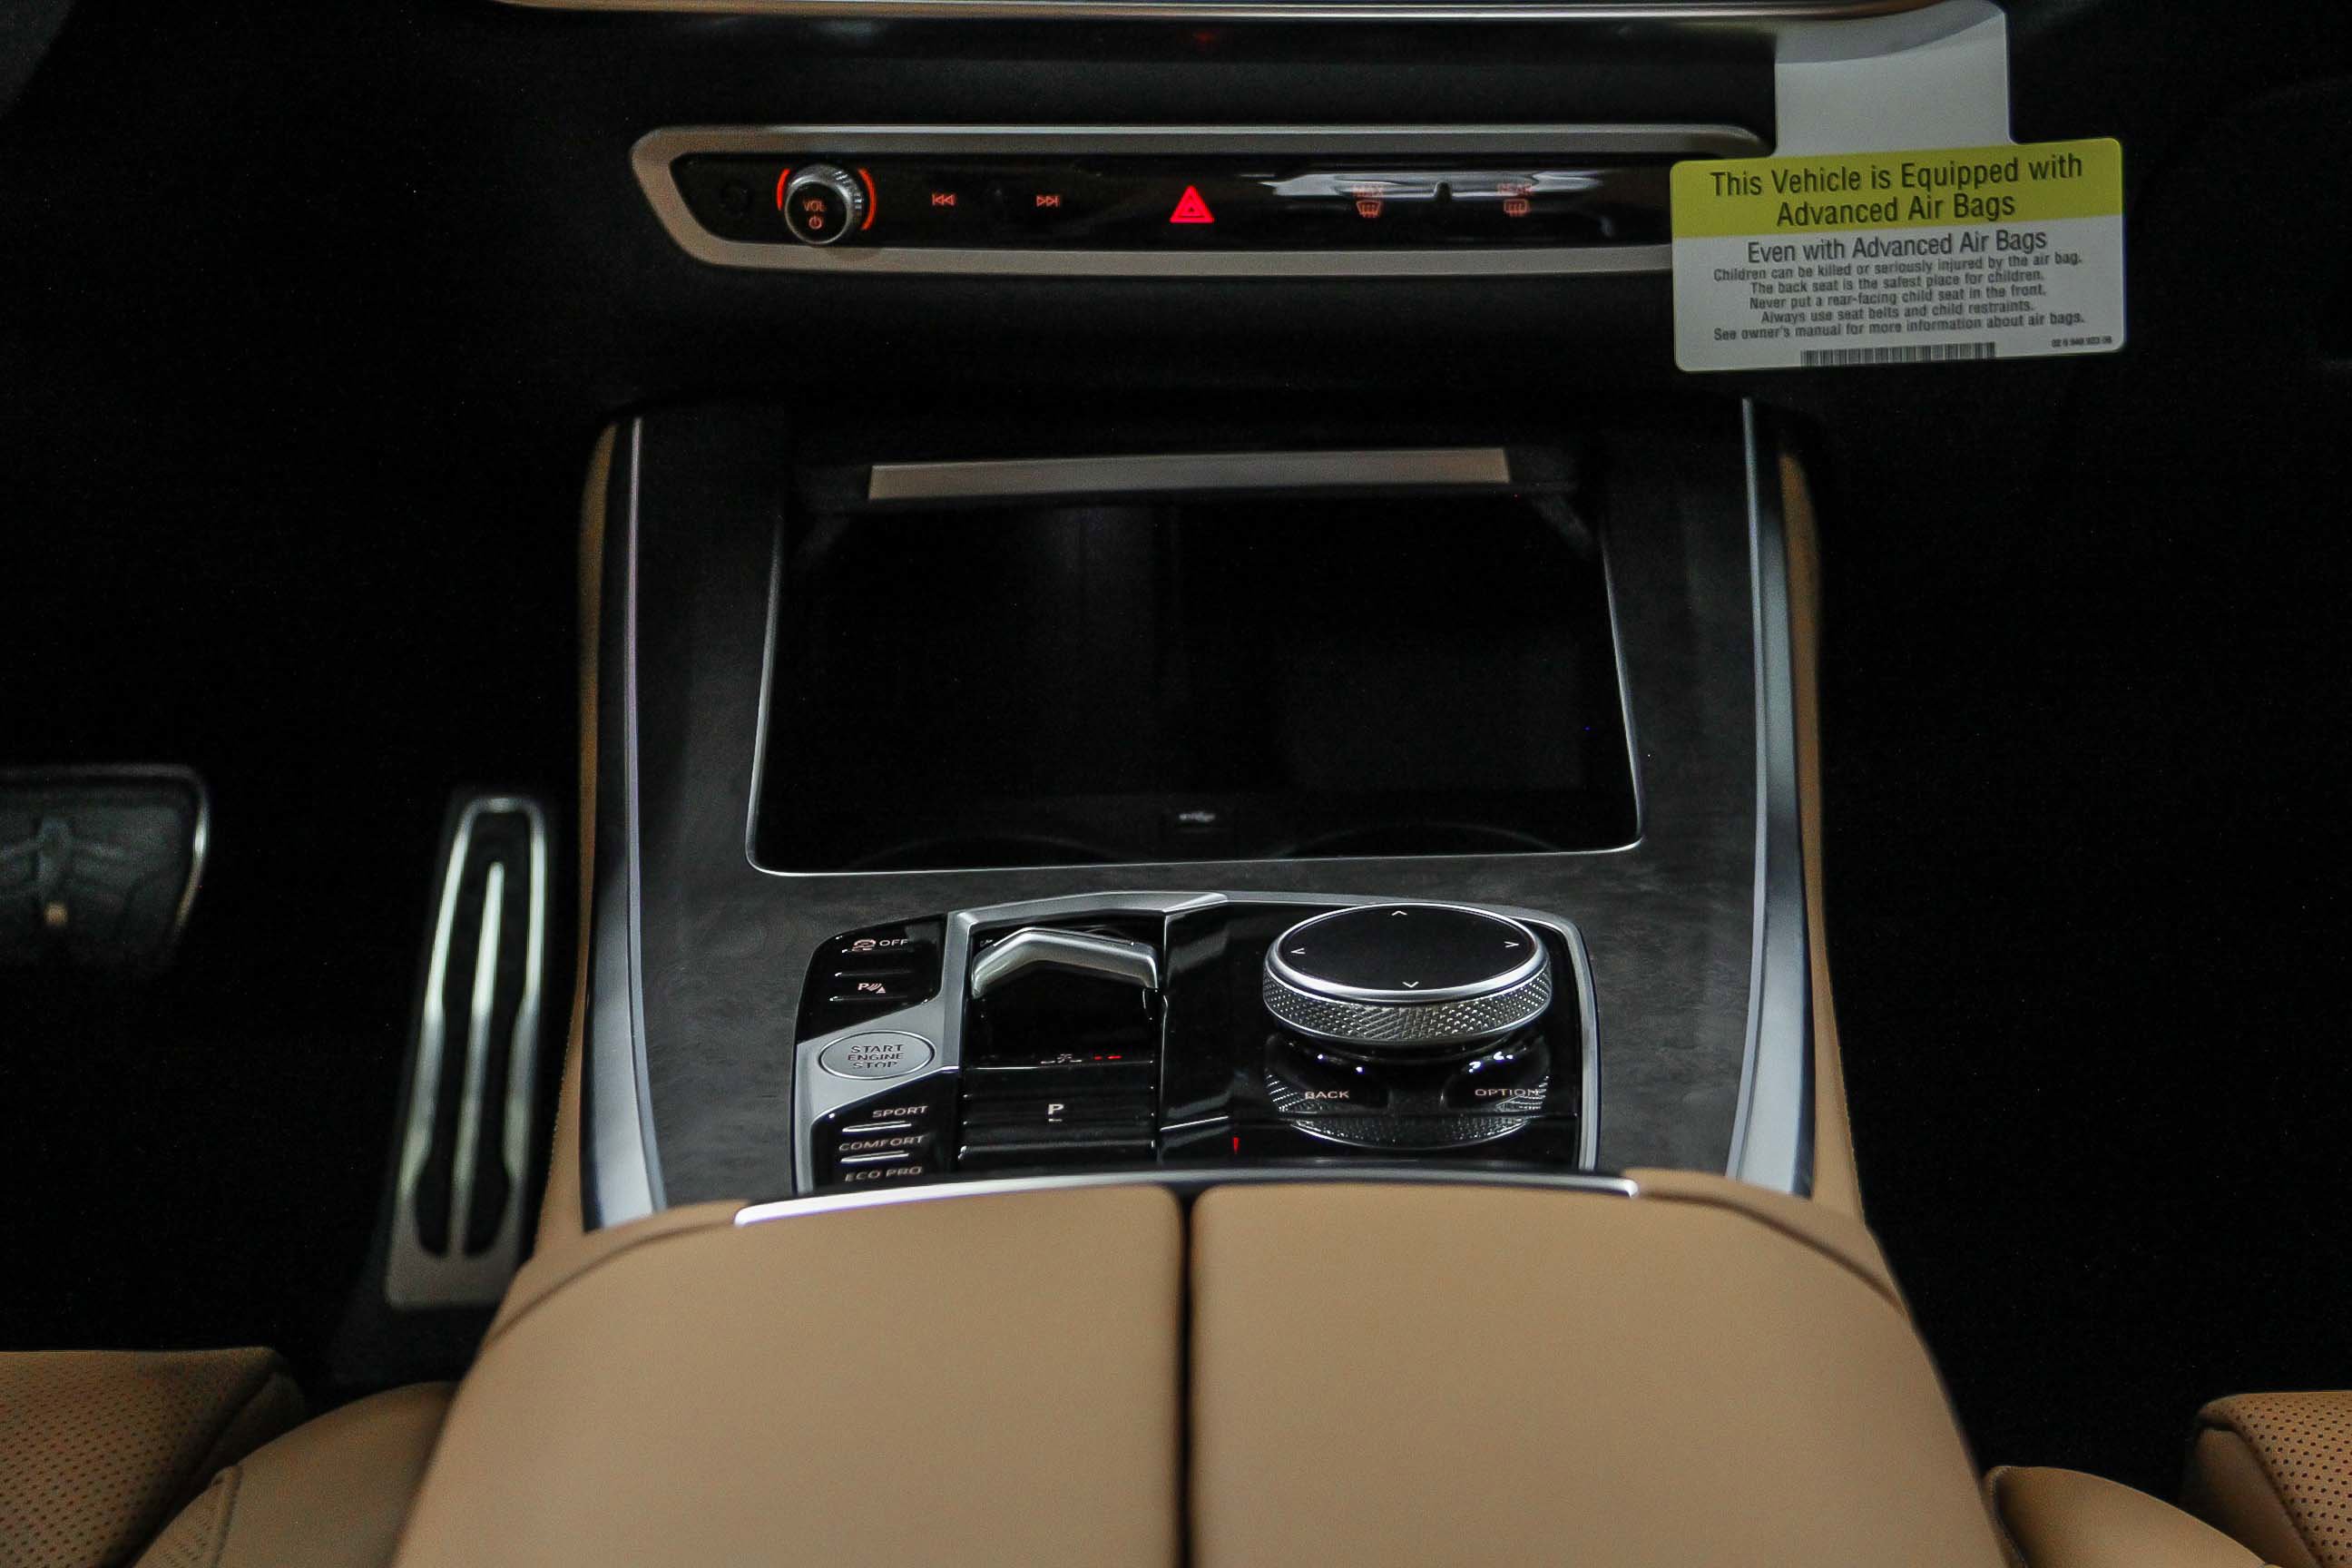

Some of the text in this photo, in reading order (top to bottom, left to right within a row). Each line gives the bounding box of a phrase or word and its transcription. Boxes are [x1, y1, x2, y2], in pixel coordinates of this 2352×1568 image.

[1710, 152, 2082, 196] This Vehicle is Equipped with
[803, 200, 827, 211] VOL
[1777, 193, 2015, 226] Advanced Air Bags
[1748, 229, 2047, 263] Even with Advanced Air Bags
[1713, 251, 2082, 281] Children can be killed or seriously injured by the air bag.
[1750, 270, 2043, 294] The back seat is the safest place for children.
[1749, 297, 1785, 309] Never
[1790, 297, 1811, 309] put
[1828, 292, 1896, 307] rear-facing
[1902, 289, 1932, 303] child
[1938, 289, 1965, 300] seat
[1969, 288, 1981, 299] in
[1986, 286, 2005, 298] the
[2011, 283, 2046, 297] front.
[1761, 300, 2034, 325] Always use seat belts and child restraints.
[1713, 312, 2084, 340] See owner's manual for more information about air bags.
[879, 938, 908, 946] OFF
[851, 1044, 905, 1053] START
[848, 1053, 905, 1061] ENGINE
[853, 1061, 897, 1069] STOP
[1304, 1091, 1350, 1100] BACK
[1475, 1088, 1539, 1096] OPTION
[872, 1106, 927, 1118] SPORT
[1047, 1103, 1064, 1115] P
[838, 1135, 924, 1152] COMFORT
[845, 1166, 922, 1181] ECO PRO
